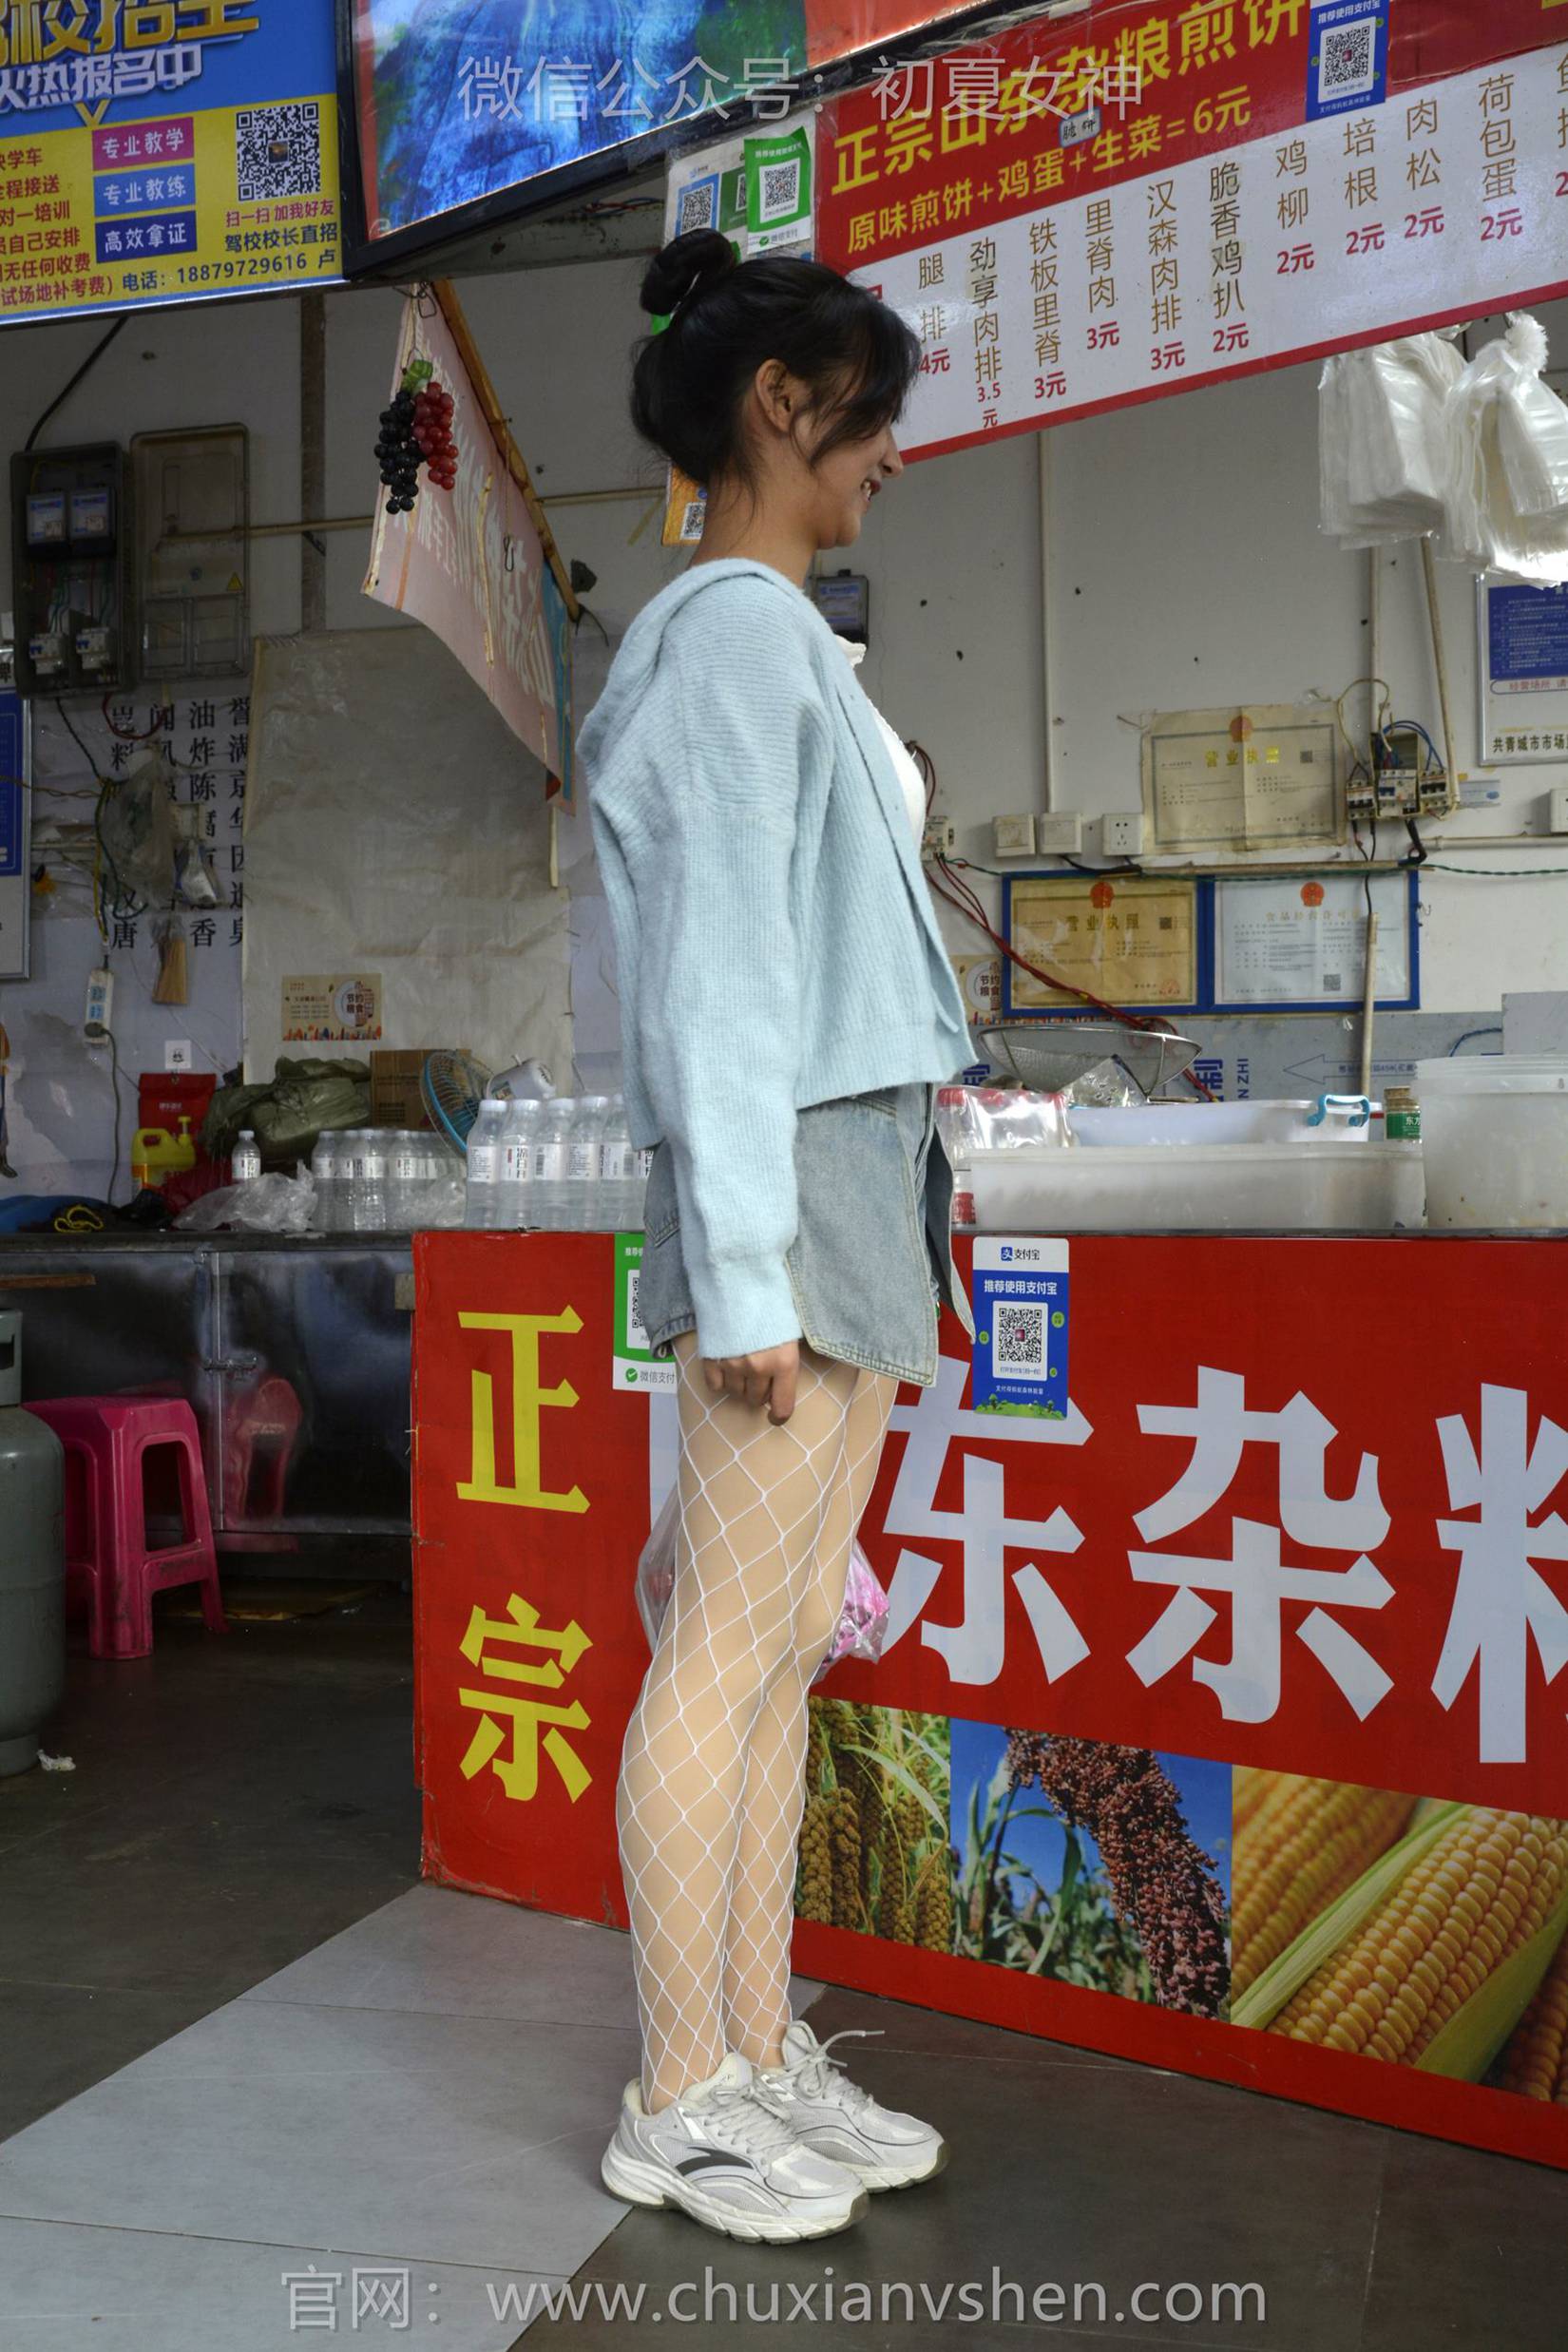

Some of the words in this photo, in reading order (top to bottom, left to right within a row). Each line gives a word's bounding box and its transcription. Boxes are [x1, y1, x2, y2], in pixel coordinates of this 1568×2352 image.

[0, 44, 202, 110] 火热报名中
[832, 0, 1303, 196] 正宗山东杂粮煎饼
[102, 128, 186, 160] 专业教学
[1405, 98, 1442, 191] 肉松
[1478, 73, 1517, 202] 荷包蛋
[847, 85, 1252, 255] 原味煎饼+鸡蛋+生菜=6元
[1343, 121, 1378, 209] 培根
[103, 174, 187, 206] 专业教练
[1274, 139, 1309, 230] 鸡柳
[225, 206, 271, 229] 扫一扫
[275, 199, 335, 223] 加我好友
[1404, 205, 1445, 239] 2元
[1480, 207, 1522, 242] 2元
[104, 221, 188, 254] 高效拿证
[224, 222, 339, 254] 驾校校长直招
[1209, 161, 1246, 320] 脆香鸡扒
[1345, 222, 1386, 257] 2元
[0, 254, 91, 283] 无任何收费
[178, 252, 308, 285] 18879729616
[317, 249, 336, 270] 卢
[1084, 199, 1116, 314] 里脊肉
[1146, 180, 1182, 335] 汉森肉排
[1277, 242, 1315, 277] 2元
[918, 252, 947, 345] 腿排
[968, 236, 1003, 383] 劲享肉排
[1029, 218, 1061, 369] 铁板里脊
[1086, 321, 1120, 351] 3元
[1213, 322, 1250, 353] 2元
[919, 348, 950, 374] 4元
[1150, 341, 1185, 371] 3元
[977, 382, 1001, 403] 3.5
[1035, 372, 1066, 399] 3元
[983, 409, 999, 429] 元
[1493, 733, 1568, 754] 共青城市市场
[1237, 1058, 1250, 1084] ZHI
[1014, 1249, 1041, 1261] 支付宝
[985, 1279, 1058, 1296] 推荐使用支付宝
[456, 1303, 594, 1805] 正宗
